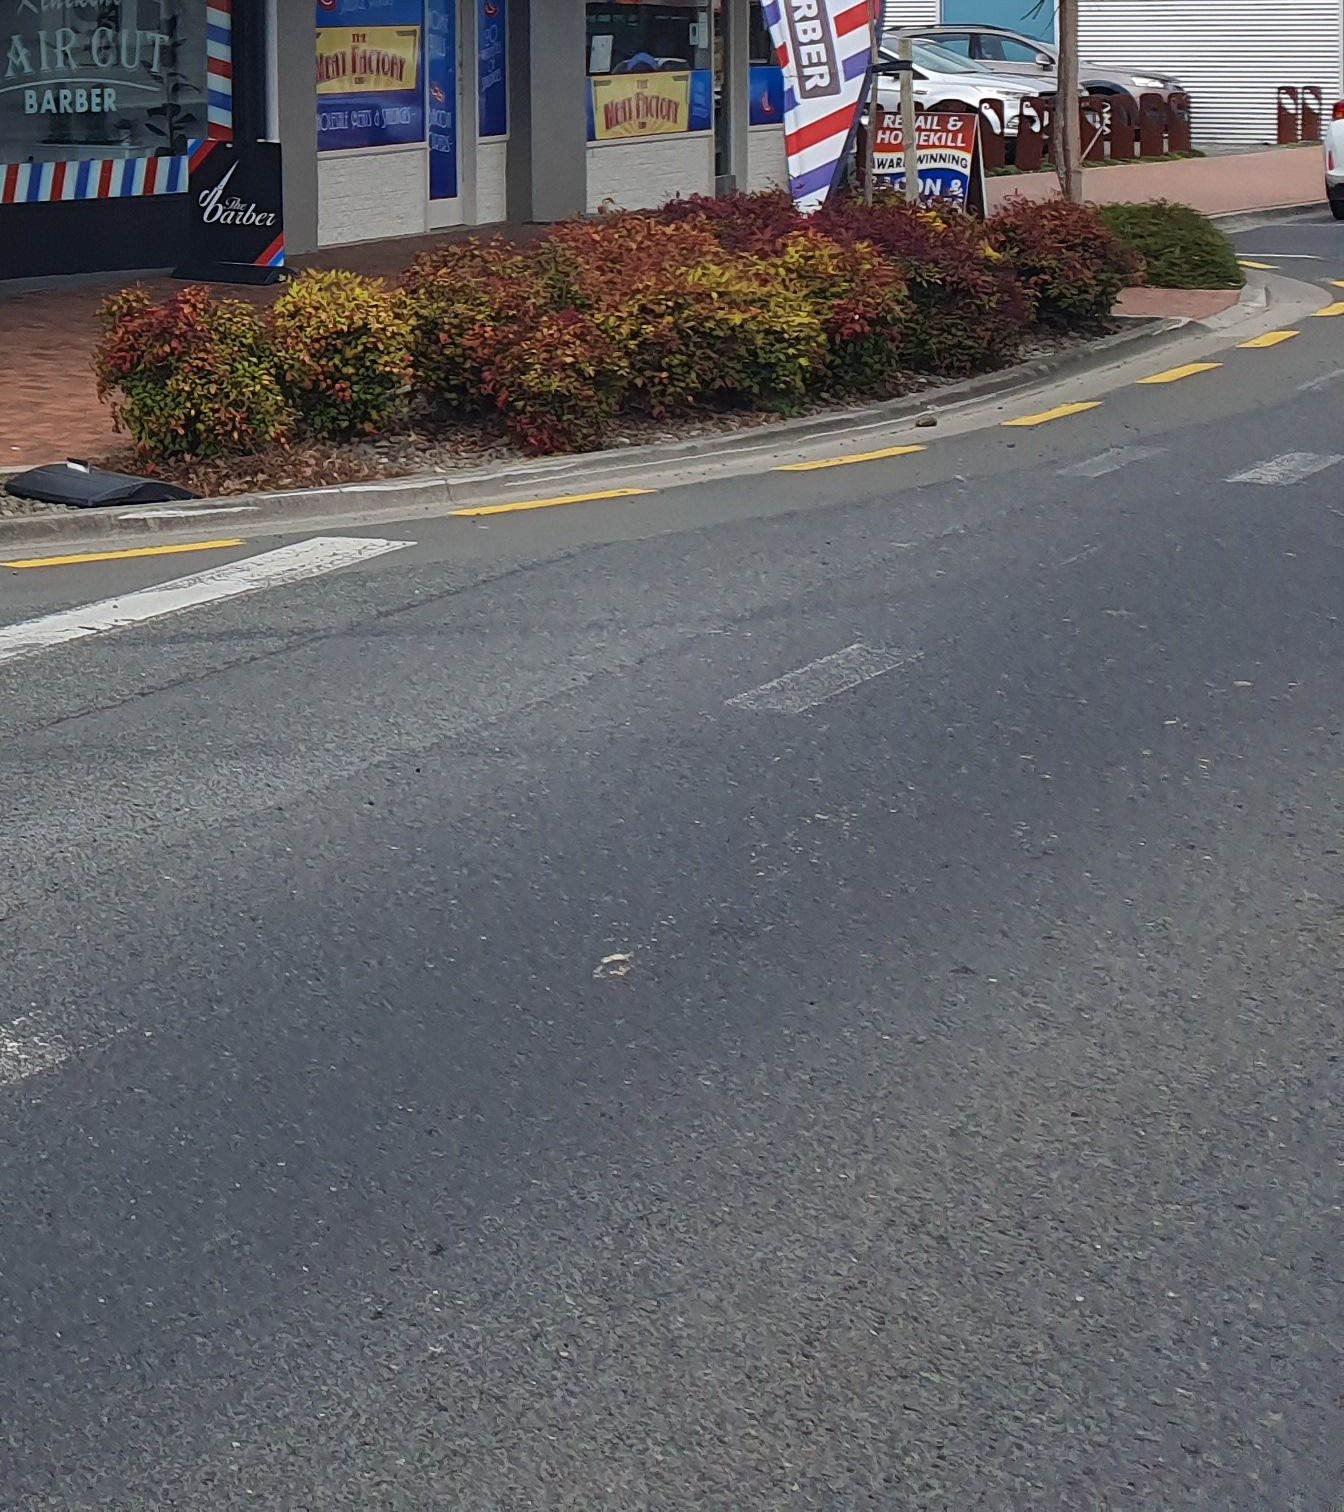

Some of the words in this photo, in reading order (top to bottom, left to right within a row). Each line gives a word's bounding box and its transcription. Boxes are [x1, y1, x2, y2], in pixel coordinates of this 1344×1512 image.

[90, 29, 171, 73] CUT
[351, 45, 407, 82] FACTORY
[23, 88, 118, 115] BARBER
[635, 91, 681, 125] FACTORY
[883, 114, 941, 129] REAIL
[947, 116, 964, 131] &
[225, 196, 248, 211] The
